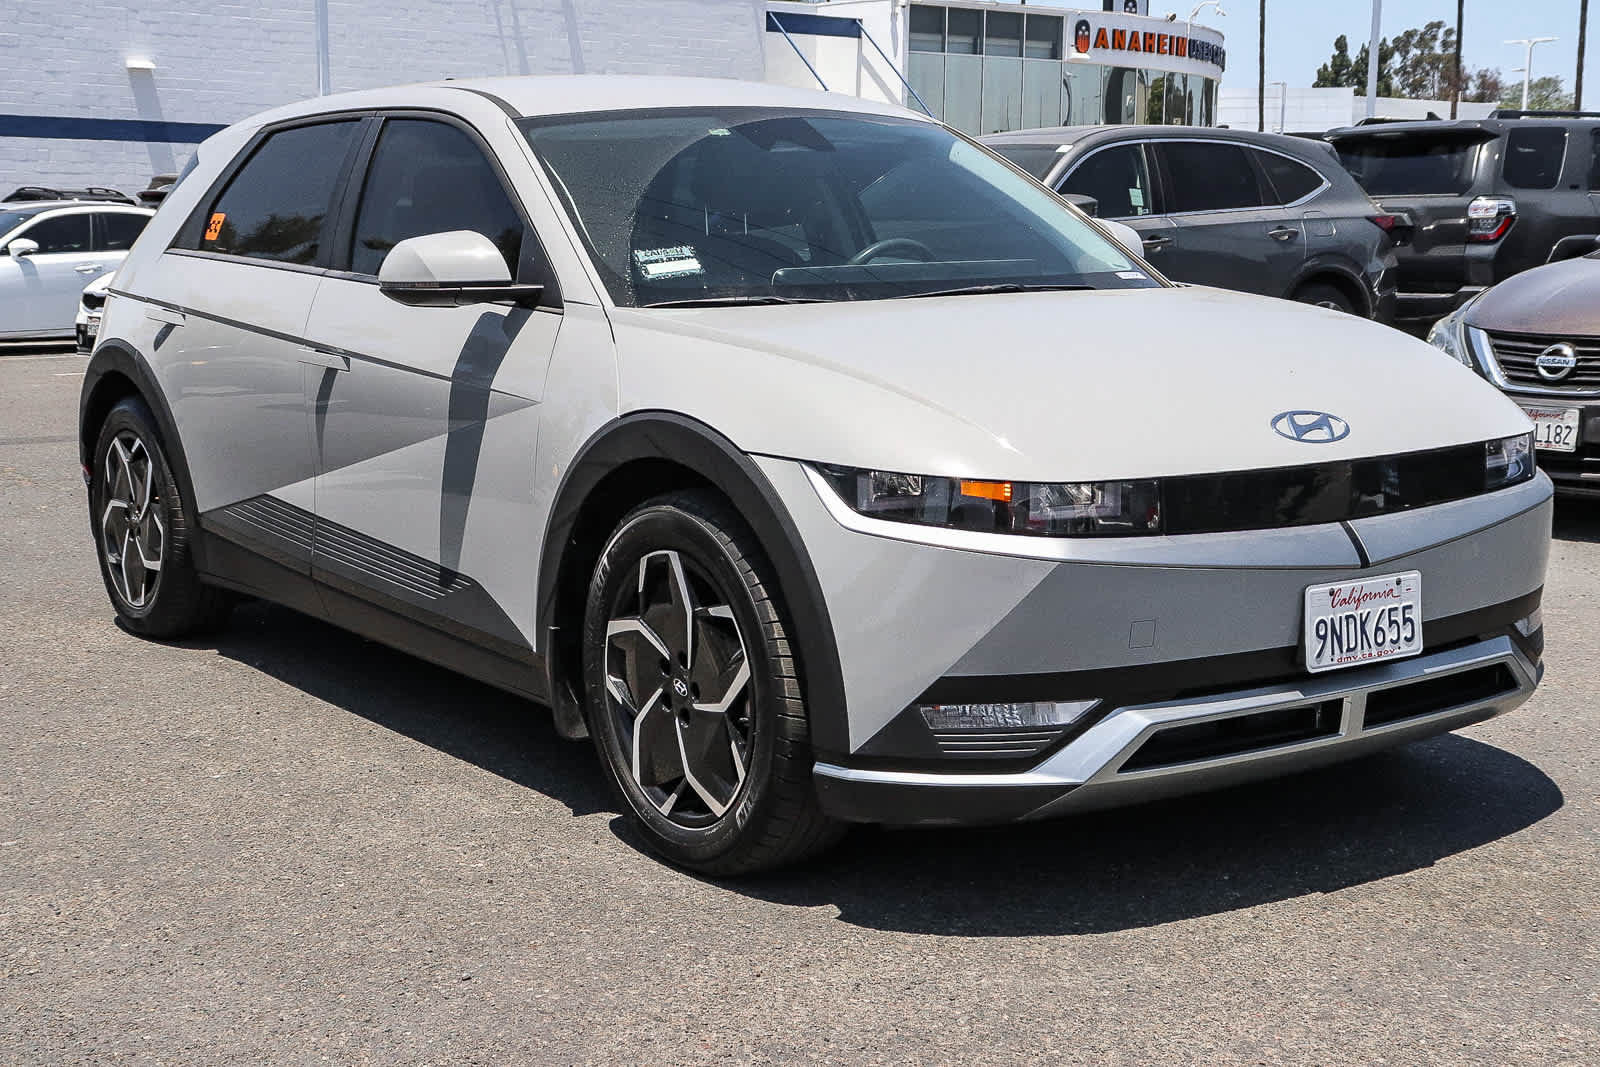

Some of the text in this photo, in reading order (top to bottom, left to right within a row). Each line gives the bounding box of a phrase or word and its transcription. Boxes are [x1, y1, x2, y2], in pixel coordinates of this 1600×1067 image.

[1094, 27, 1188, 57] ANAHEIM
[1331, 584, 1400, 610] California
[1315, 604, 1416, 659] 9NDK655
